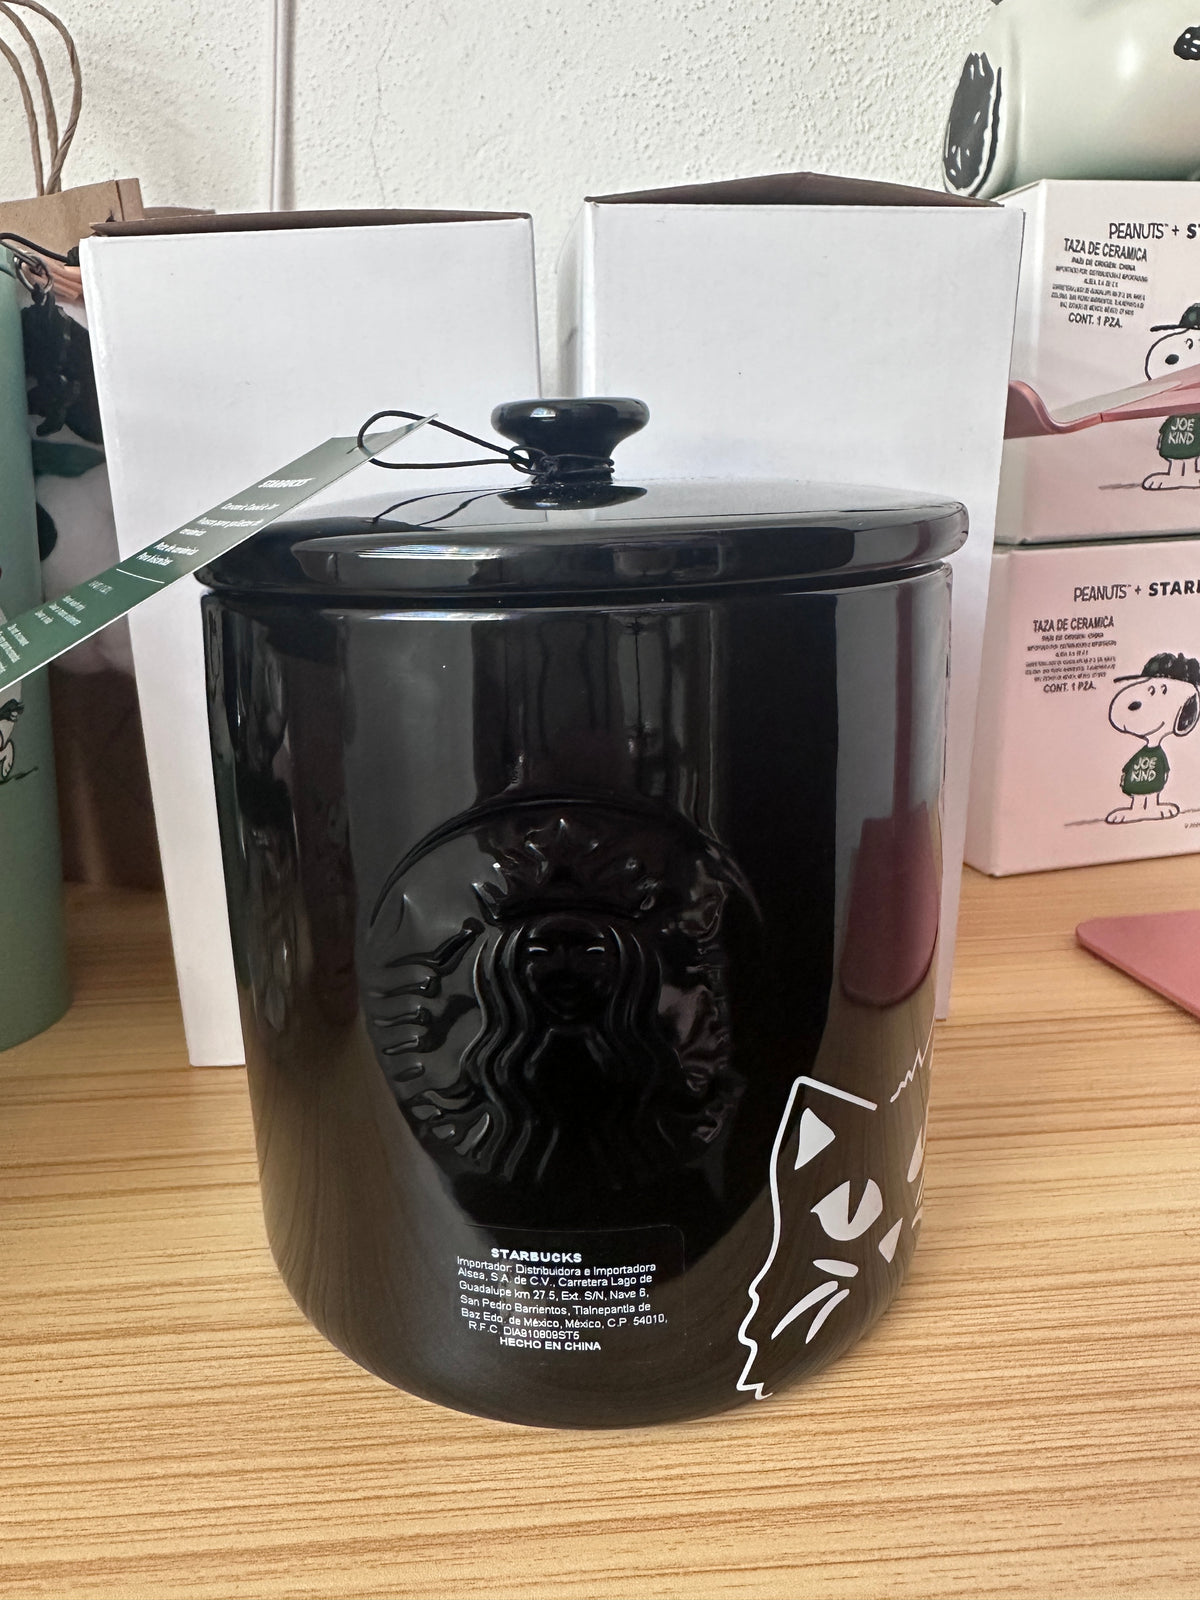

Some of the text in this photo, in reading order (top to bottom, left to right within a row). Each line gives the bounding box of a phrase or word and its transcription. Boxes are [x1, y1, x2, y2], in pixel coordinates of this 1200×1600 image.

[1064, 238, 1086, 254] TAZA
[1088, 241, 1101, 256] DE
[1068, 312, 1123, 328] CONT. 1 PZA.
[1171, 417, 1195, 432] JOE
[1168, 431, 1195, 445] KIND
[1033, 619, 1055, 633] TAZA
[1056, 617, 1068, 631] DE
[1043, 680, 1096, 694] CONT. 1 PZA.
[1133, 756, 1157, 770] JOE
[1131, 769, 1157, 782] KIND
[491, 1248, 582, 1263] STARBUCKS
[458, 1267, 488, 1281] Alsea,
[514, 1275, 527, 1285] de
[558, 1277, 608, 1287] Carretera
[610, 1276, 637, 1287] Lago
[639, 1275, 653, 1284] de
[515, 1263, 581, 1276] Distribuidora
[584, 1268, 591, 1276] e
[593, 1263, 657, 1277] Importadora
[459, 1280, 512, 1297] Guadalupe
[514, 1289, 531, 1299] km
[561, 1290, 581, 1301] Ext.
[584, 1290, 607, 1301] S/N,
[609, 1290, 637, 1300] Nave
[639, 1288, 650, 1298] 6,
[460, 1294, 651, 1316] San Pedro Barrientos, Tlalnepantla de
[461, 1307, 481, 1320] Baz
[509, 1315, 521, 1326] de
[523, 1317, 563, 1329] México,
[565, 1318, 605, 1329] México,
[633, 1313, 668, 1326] 54010,
[500, 1337, 601, 1351] HECHO EN CHINA
